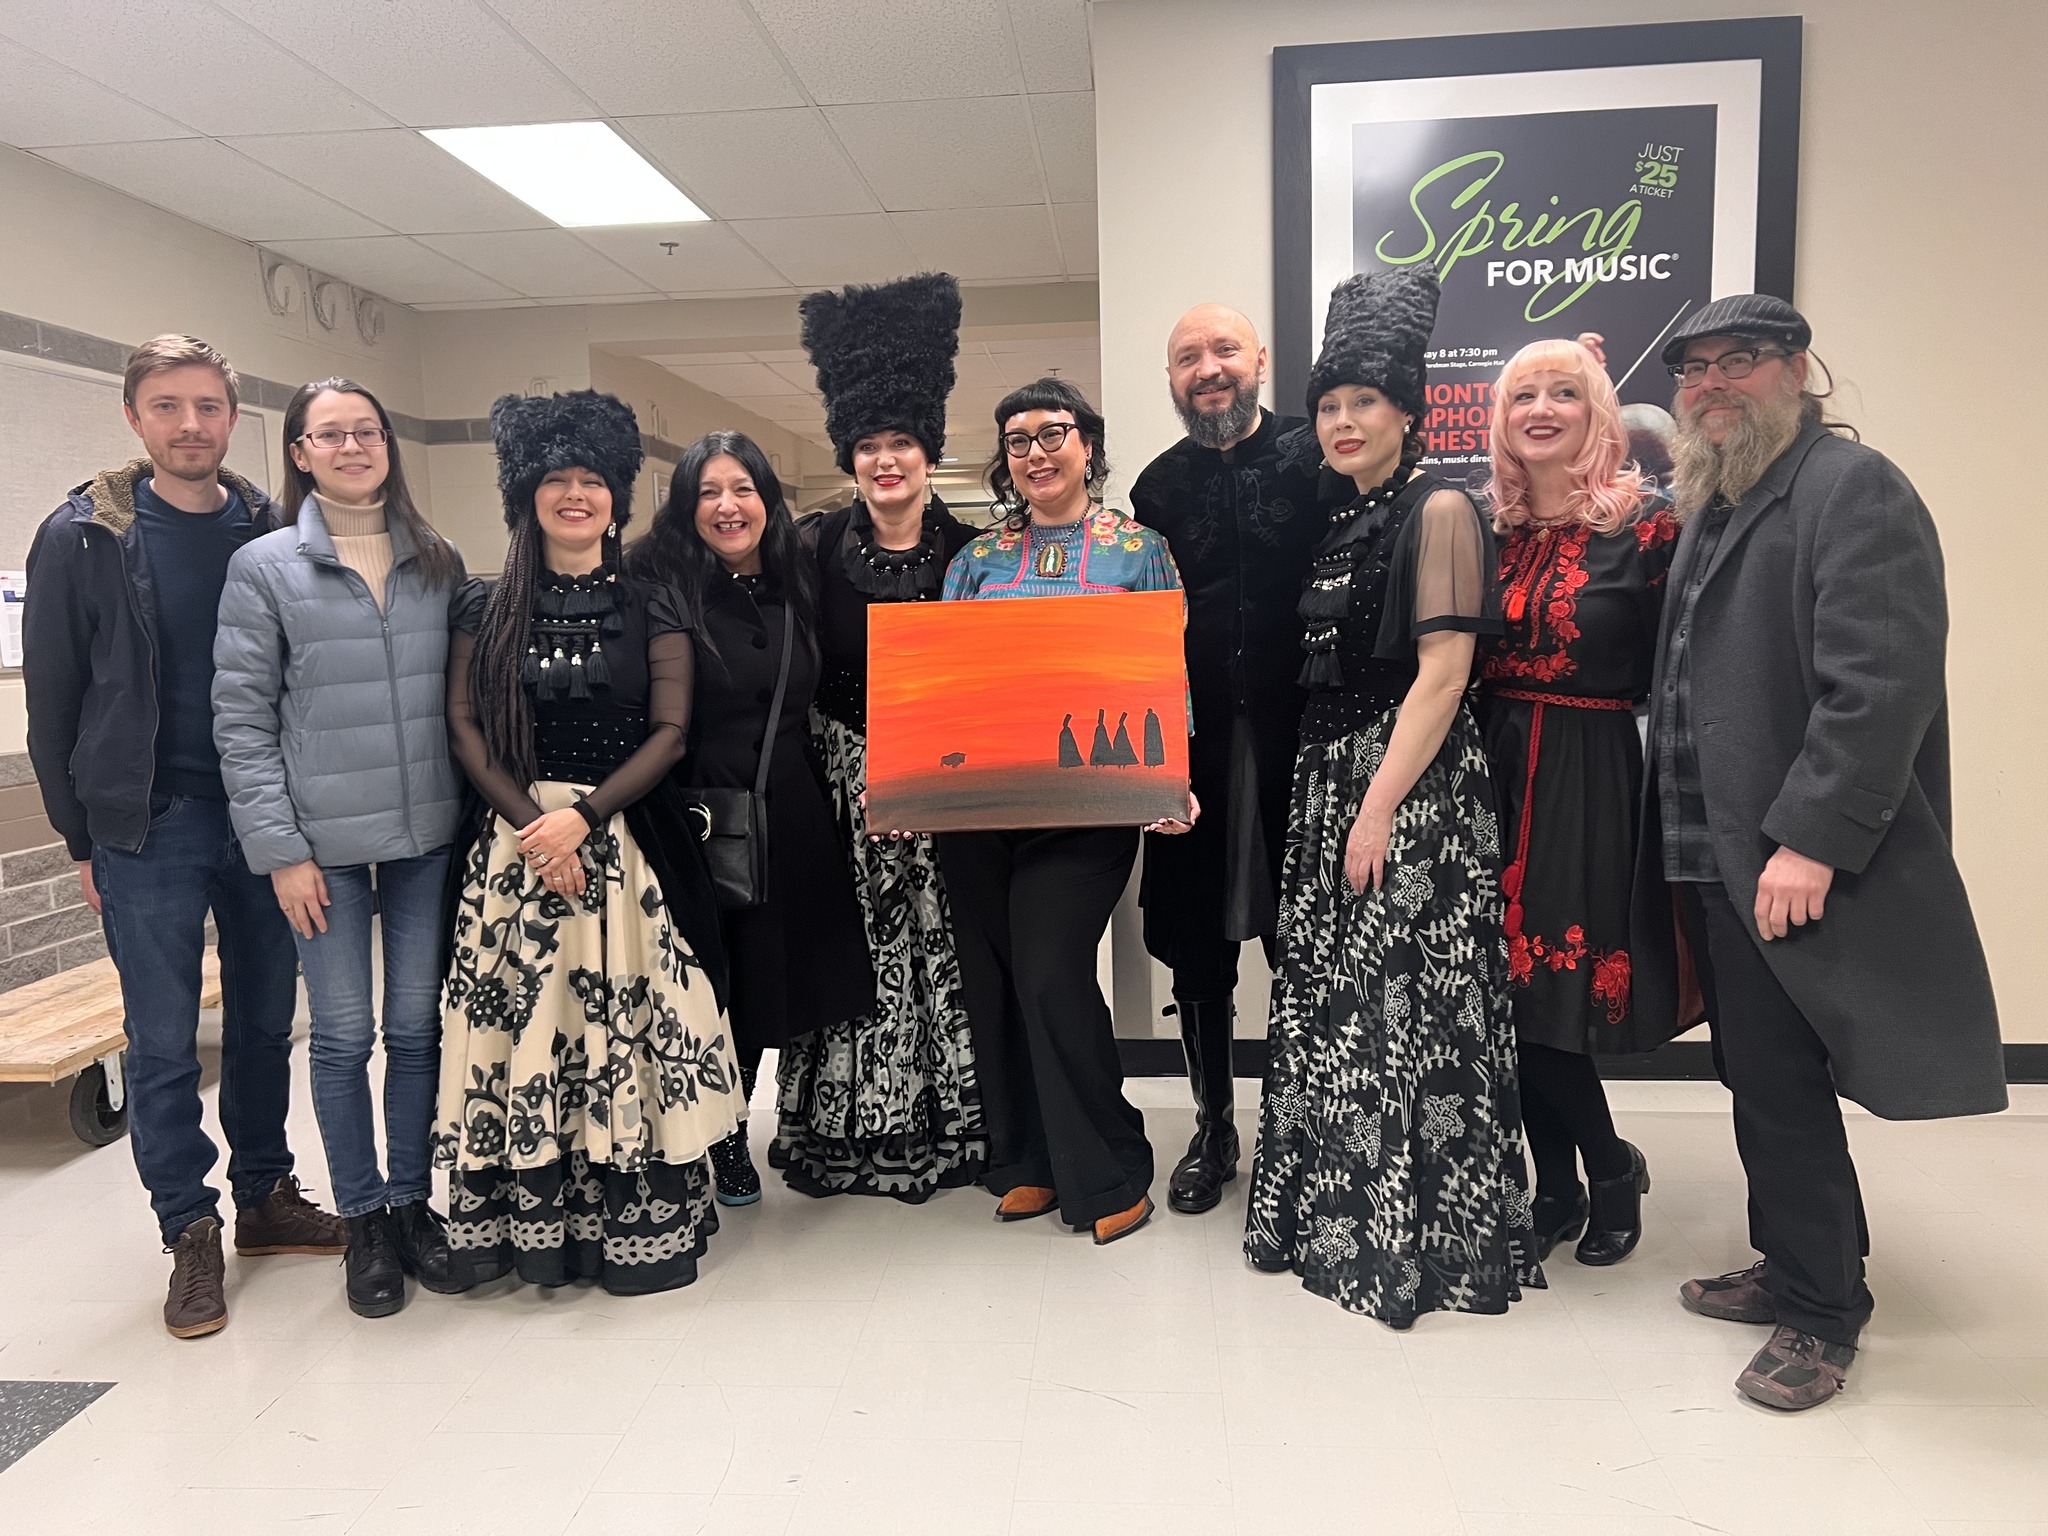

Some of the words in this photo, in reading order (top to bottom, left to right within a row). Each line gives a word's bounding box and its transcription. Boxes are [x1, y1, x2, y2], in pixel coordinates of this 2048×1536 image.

[1638, 143, 1684, 163] JUST
[1635, 161, 1679, 188] $25
[1629, 184, 1638, 193] A
[1639, 185, 1674, 199] TICKET
[1375, 150, 1642, 322] Spring
[1487, 259, 1553, 286] FOR
[1439, 349, 1446, 358] 8
[1447, 349, 1458, 358] at
[1459, 348, 1481, 357] 7:30
[1482, 349, 1498, 358] pm
[1468, 360, 1492, 368] Carnegie
[1423, 406, 1494, 428] PHO
[1417, 429, 1490, 452] HEST
[1416, 456, 1441, 466] dins,
[1442, 455, 1469, 464] music
[1470, 454, 1492, 463] direc
